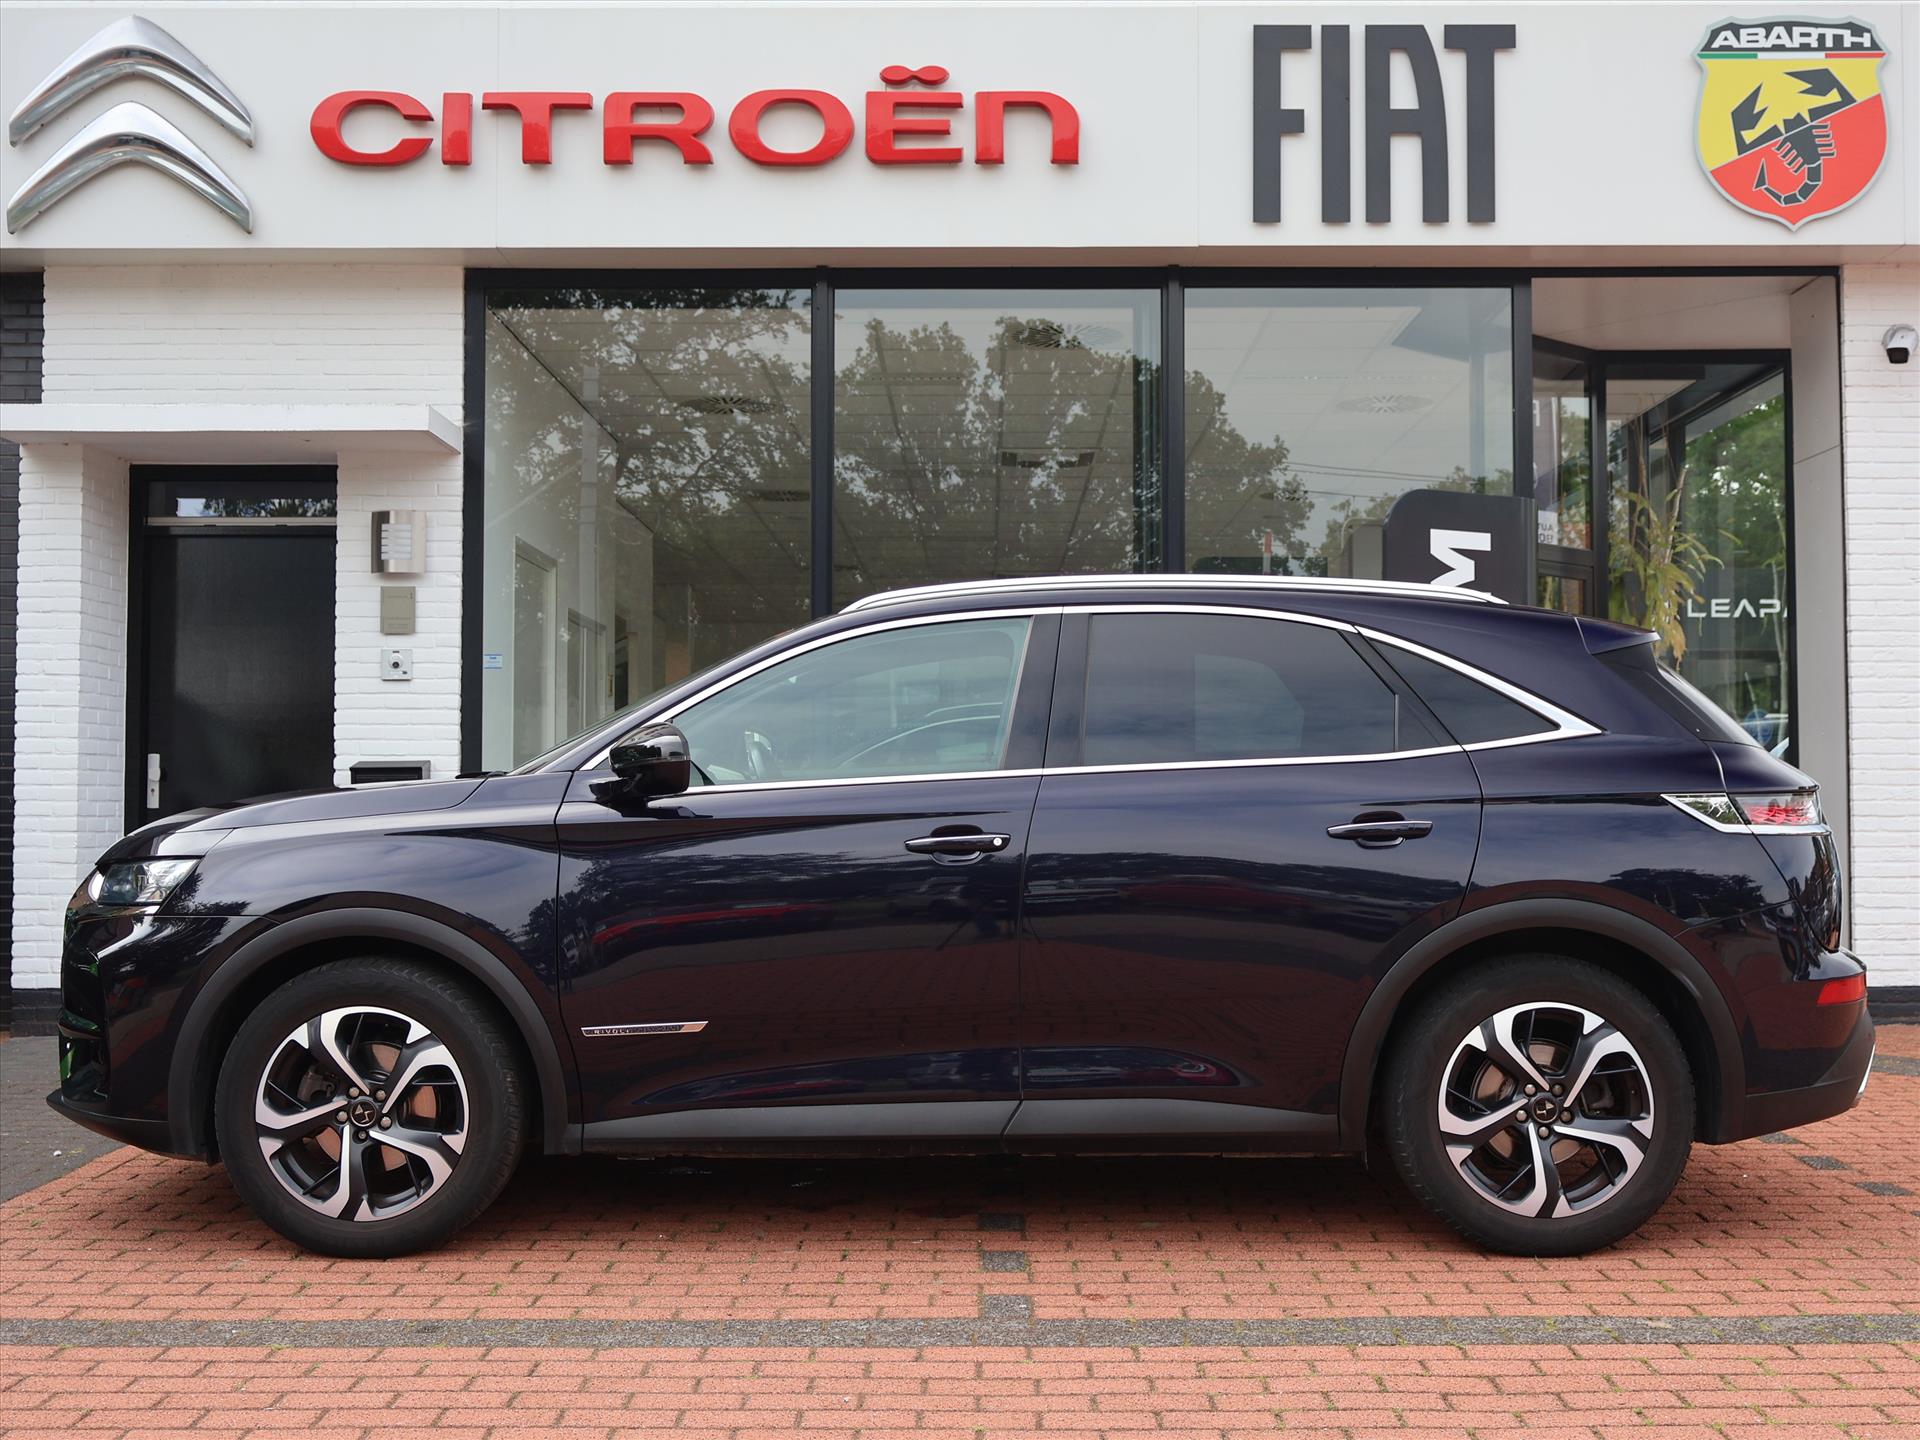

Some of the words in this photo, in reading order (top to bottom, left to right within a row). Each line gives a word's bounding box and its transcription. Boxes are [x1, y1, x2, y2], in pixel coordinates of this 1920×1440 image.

[1711, 26, 1871, 49] ABARTH
[310, 64, 1080, 166] CITROËN
[1253, 24, 1516, 223] FIAT
[1687, 598, 1787, 618] LEAP
